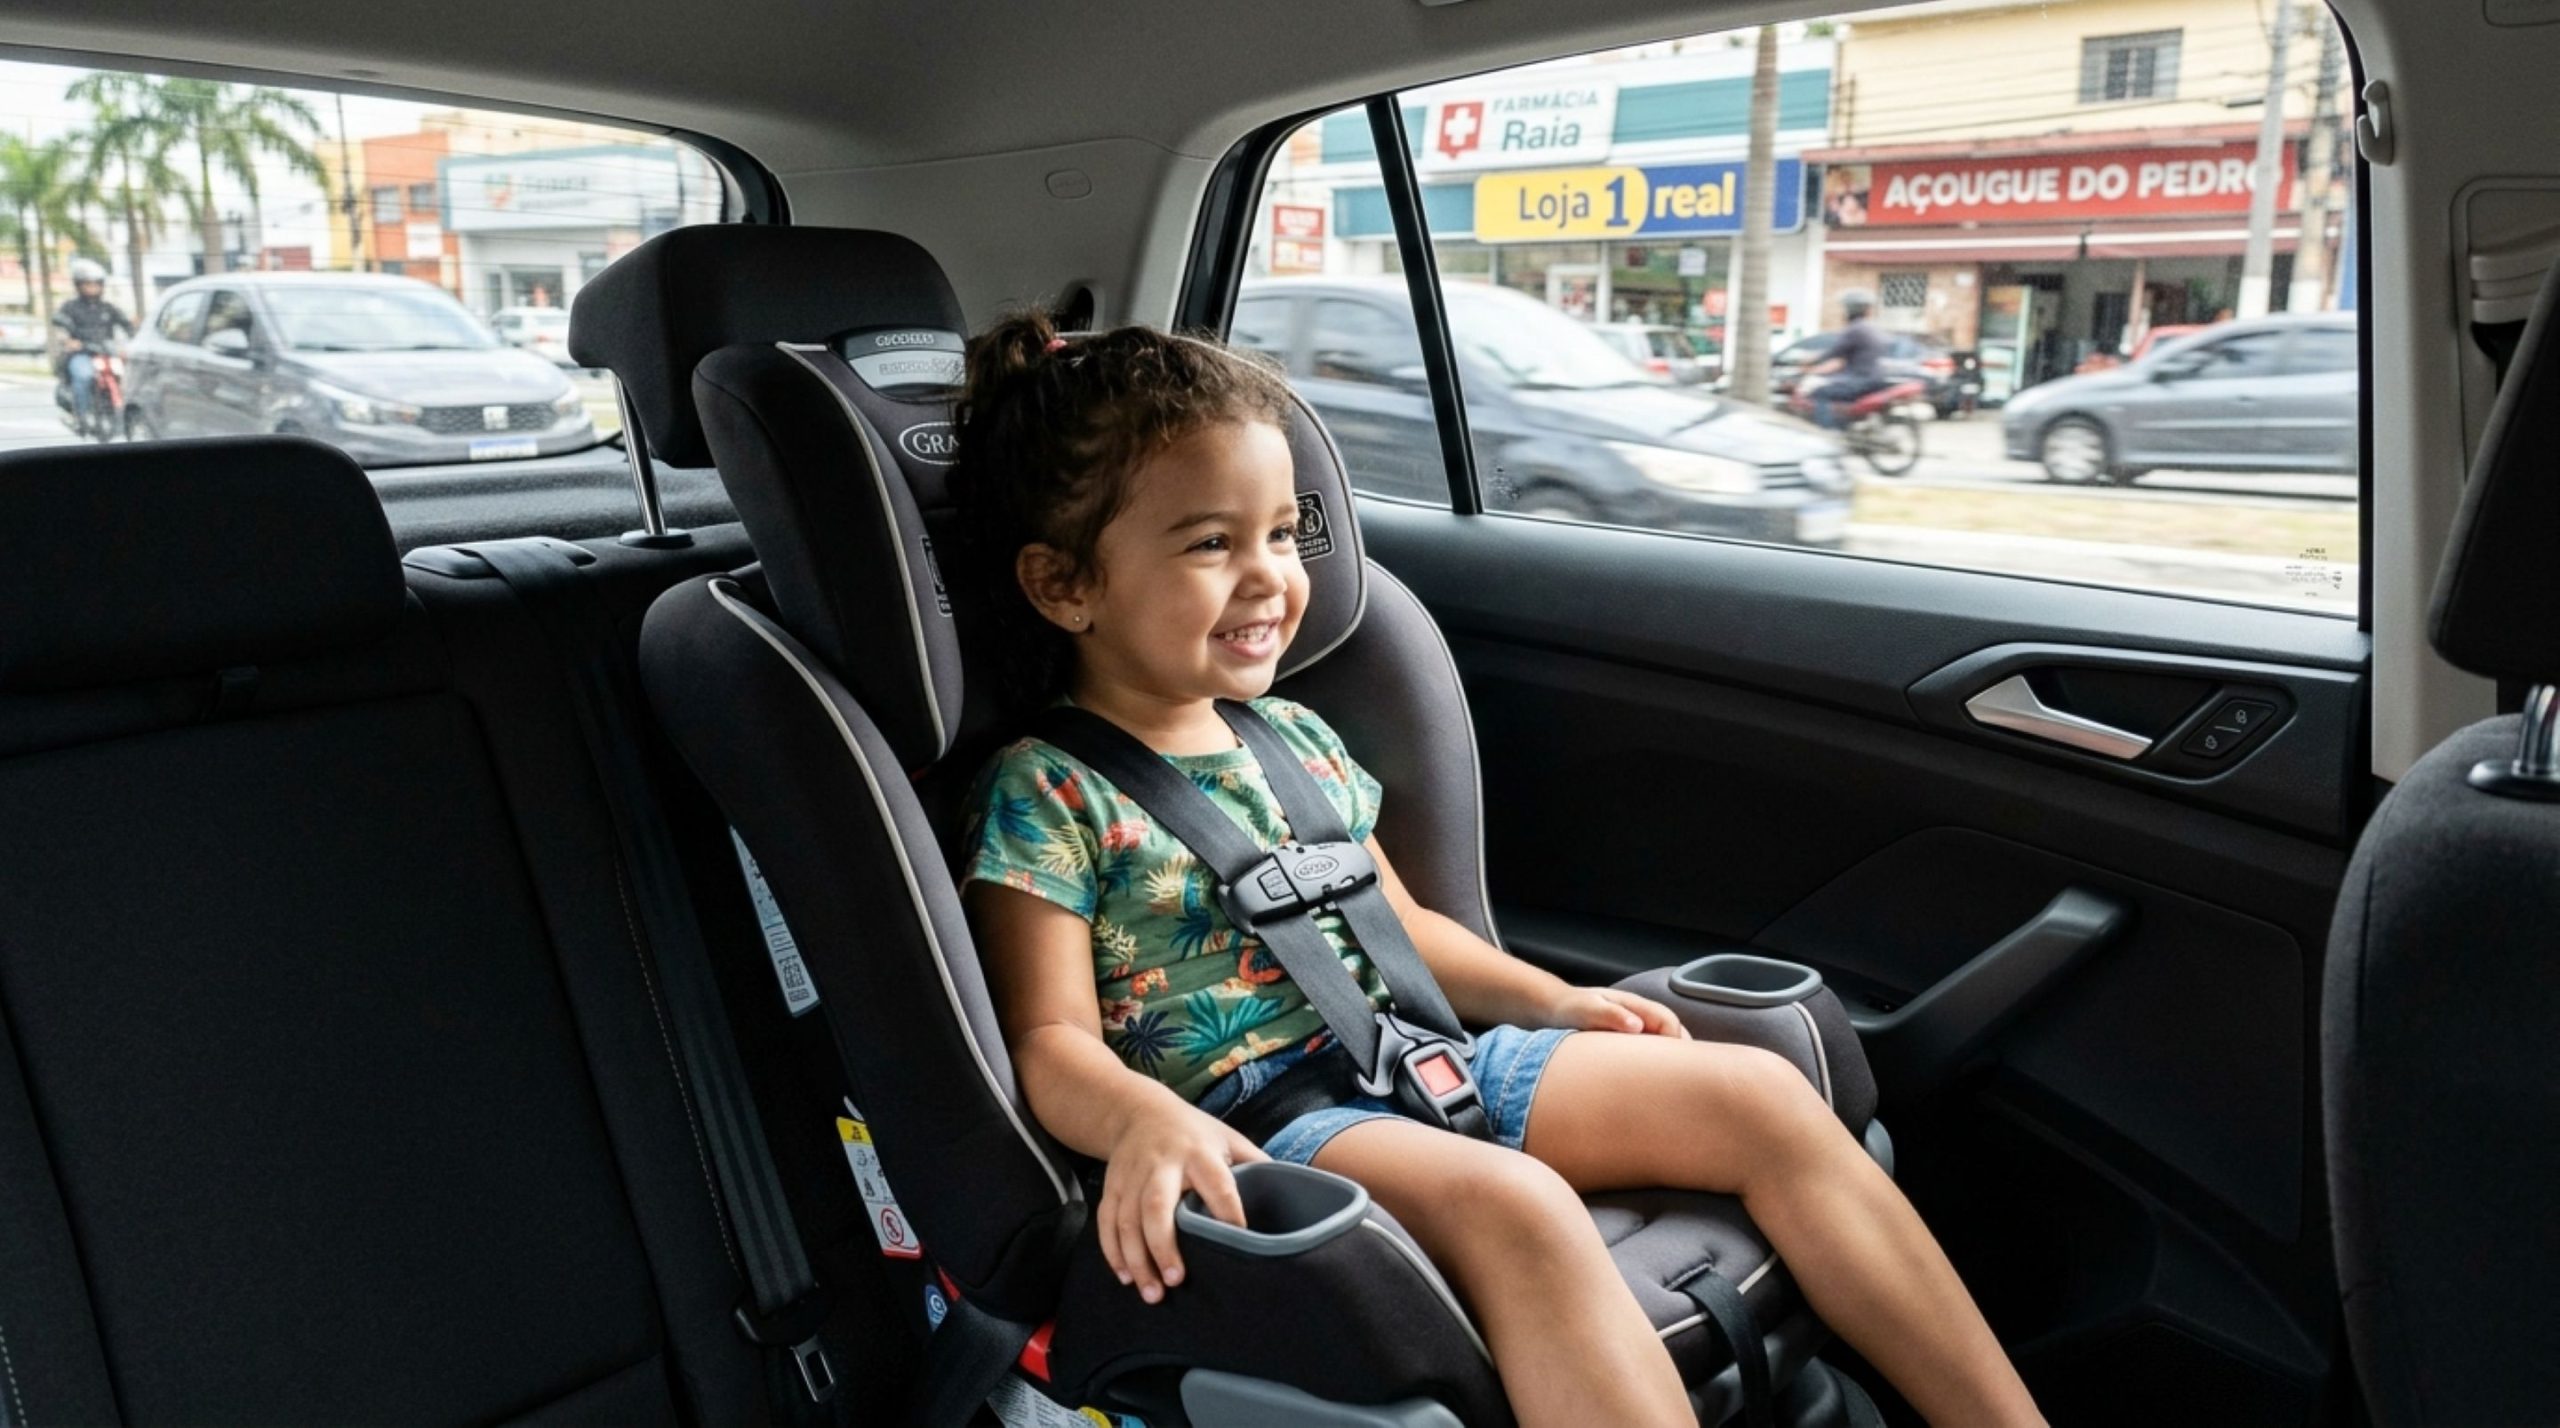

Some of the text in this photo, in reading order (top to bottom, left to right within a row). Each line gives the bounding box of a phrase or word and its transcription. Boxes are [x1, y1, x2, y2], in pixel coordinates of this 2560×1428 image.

[1502, 115, 1582, 151] Raia
[1518, 171, 1737, 229] Loja 1 real
[1882, 167, 2061, 216] AÇOUGUE
[2067, 163, 2130, 201] DO
